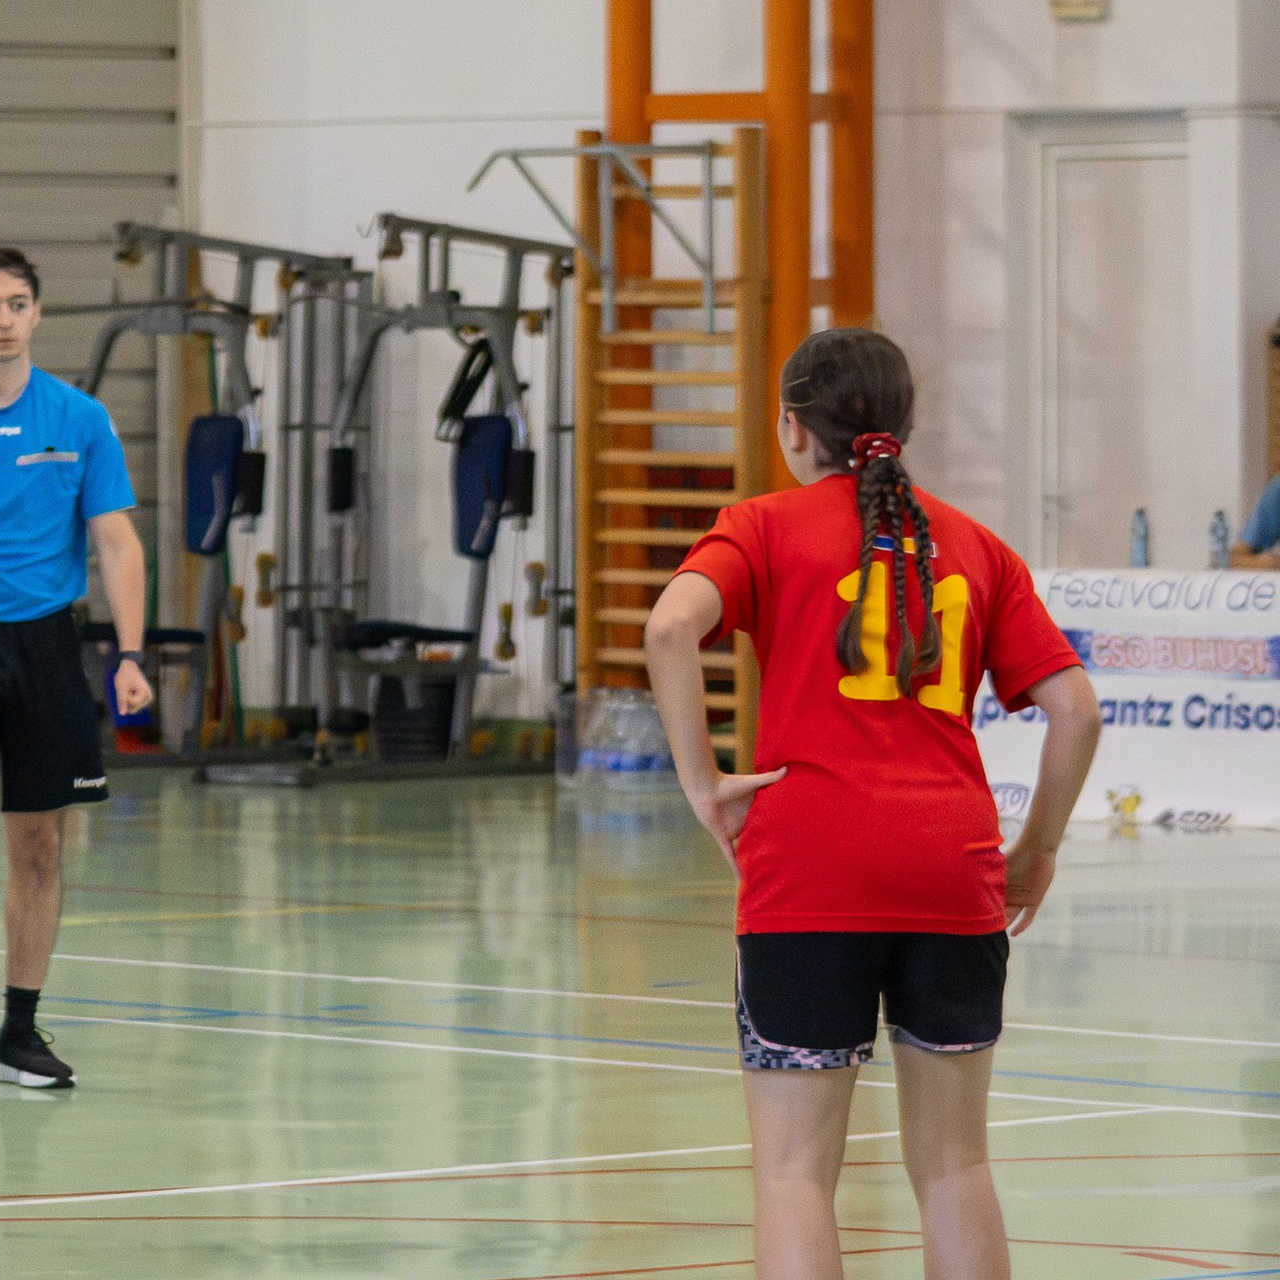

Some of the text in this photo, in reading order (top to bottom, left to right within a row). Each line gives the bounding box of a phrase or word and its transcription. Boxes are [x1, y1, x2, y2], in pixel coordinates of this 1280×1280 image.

[1046, 571, 1276, 612] Festivalul de
[836, 561, 968, 717] 11
[1099, 693, 1174, 728] antz
[1183, 692, 1280, 732] Criso
